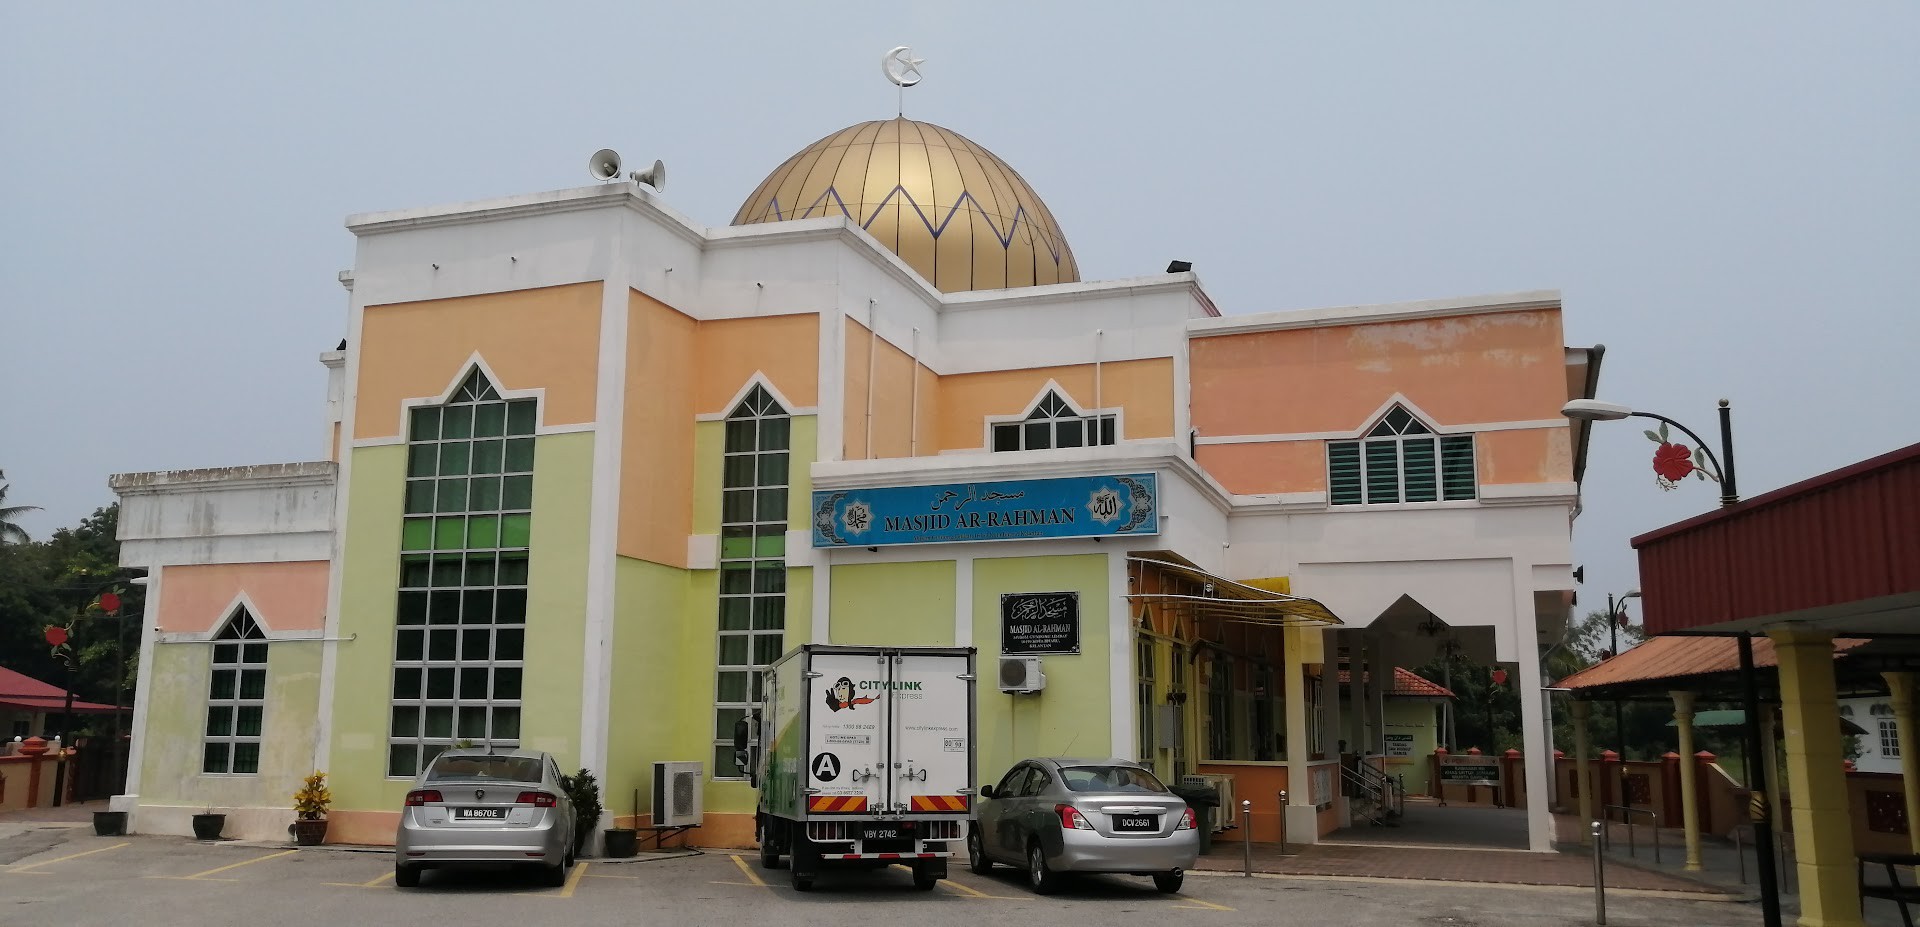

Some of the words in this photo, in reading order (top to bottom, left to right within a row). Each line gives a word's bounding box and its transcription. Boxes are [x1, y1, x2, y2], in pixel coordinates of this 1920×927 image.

[980, 490, 1025, 504] مسجد
[884, 513, 951, 533] MASJID
[955, 507, 1076, 530] AR-RAHMAN
[1010, 625, 1032, 635] MASJID
[815, 754, 837, 777] A
[473, 809, 492, 817] 8670
[864, 830, 877, 838] VBY
[878, 829, 897, 838] 2742
